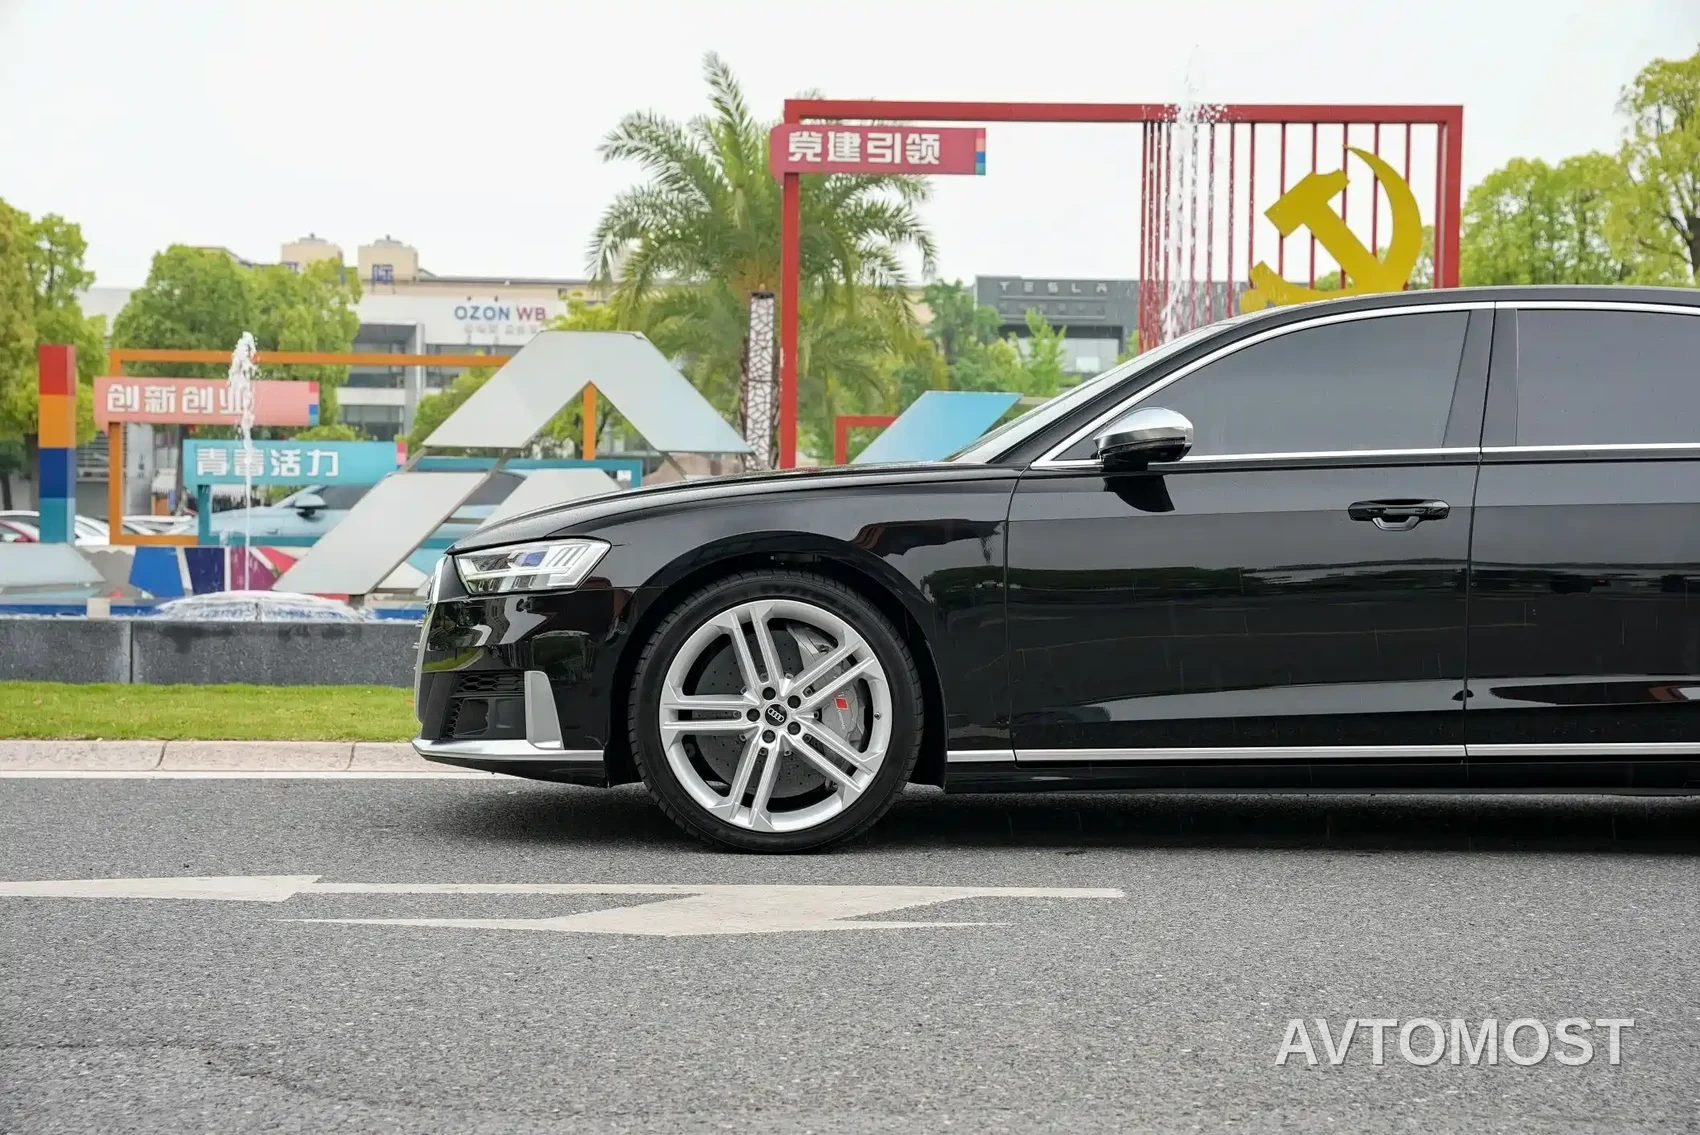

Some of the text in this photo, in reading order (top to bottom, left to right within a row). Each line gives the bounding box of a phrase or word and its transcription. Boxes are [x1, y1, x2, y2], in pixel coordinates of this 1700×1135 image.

[788, 131, 940, 165] 党建引领
[999, 281, 1108, 294] TESLA
[454, 305, 546, 321] OZON WB
